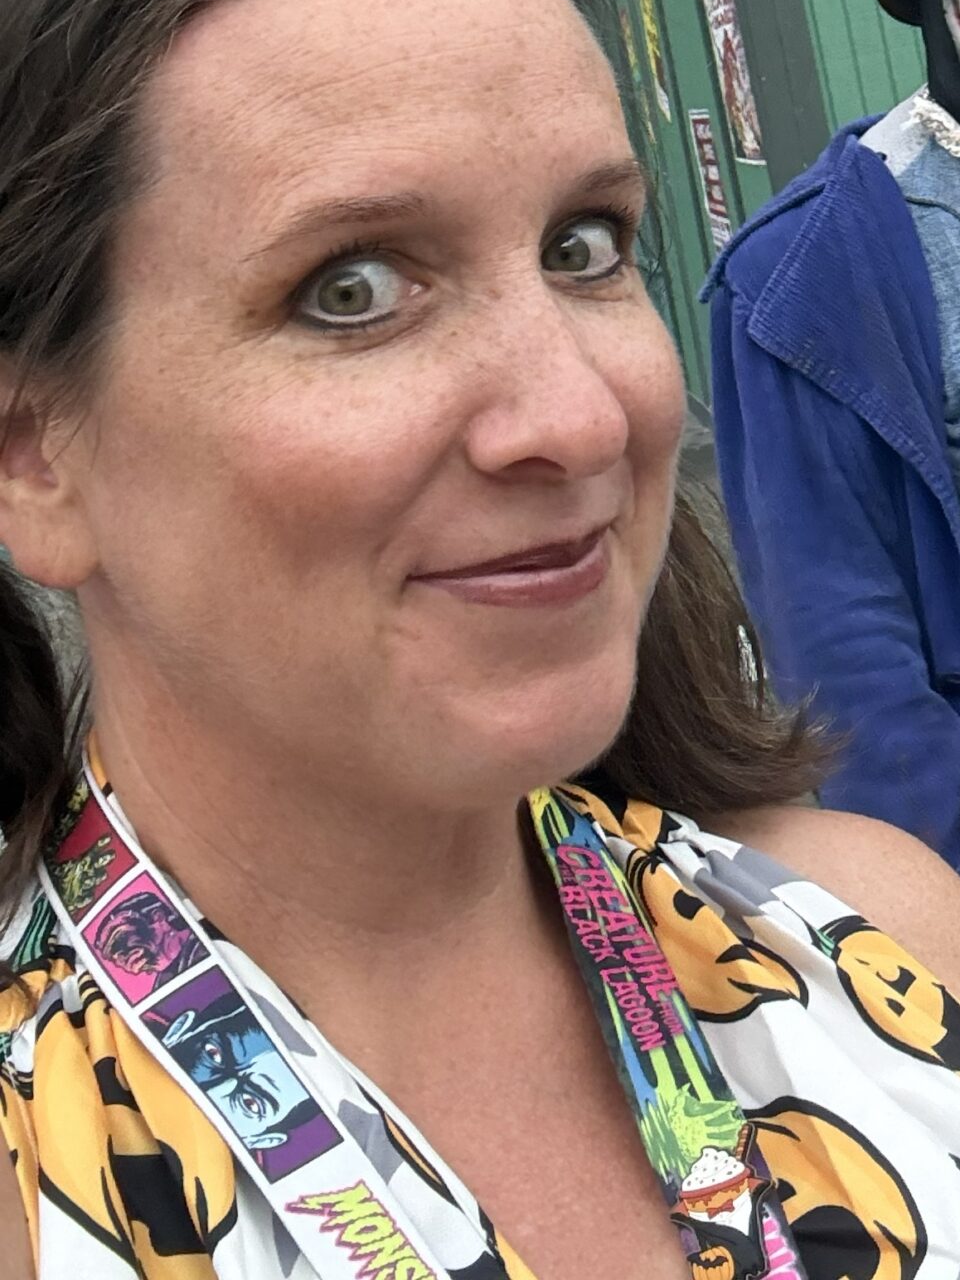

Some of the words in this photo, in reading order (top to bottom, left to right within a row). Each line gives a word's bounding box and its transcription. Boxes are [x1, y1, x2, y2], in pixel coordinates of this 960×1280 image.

[557, 843, 679, 1001] CREATURE
[559, 885, 620, 963] BLACK
[599, 966, 666, 1052] LAGOON
